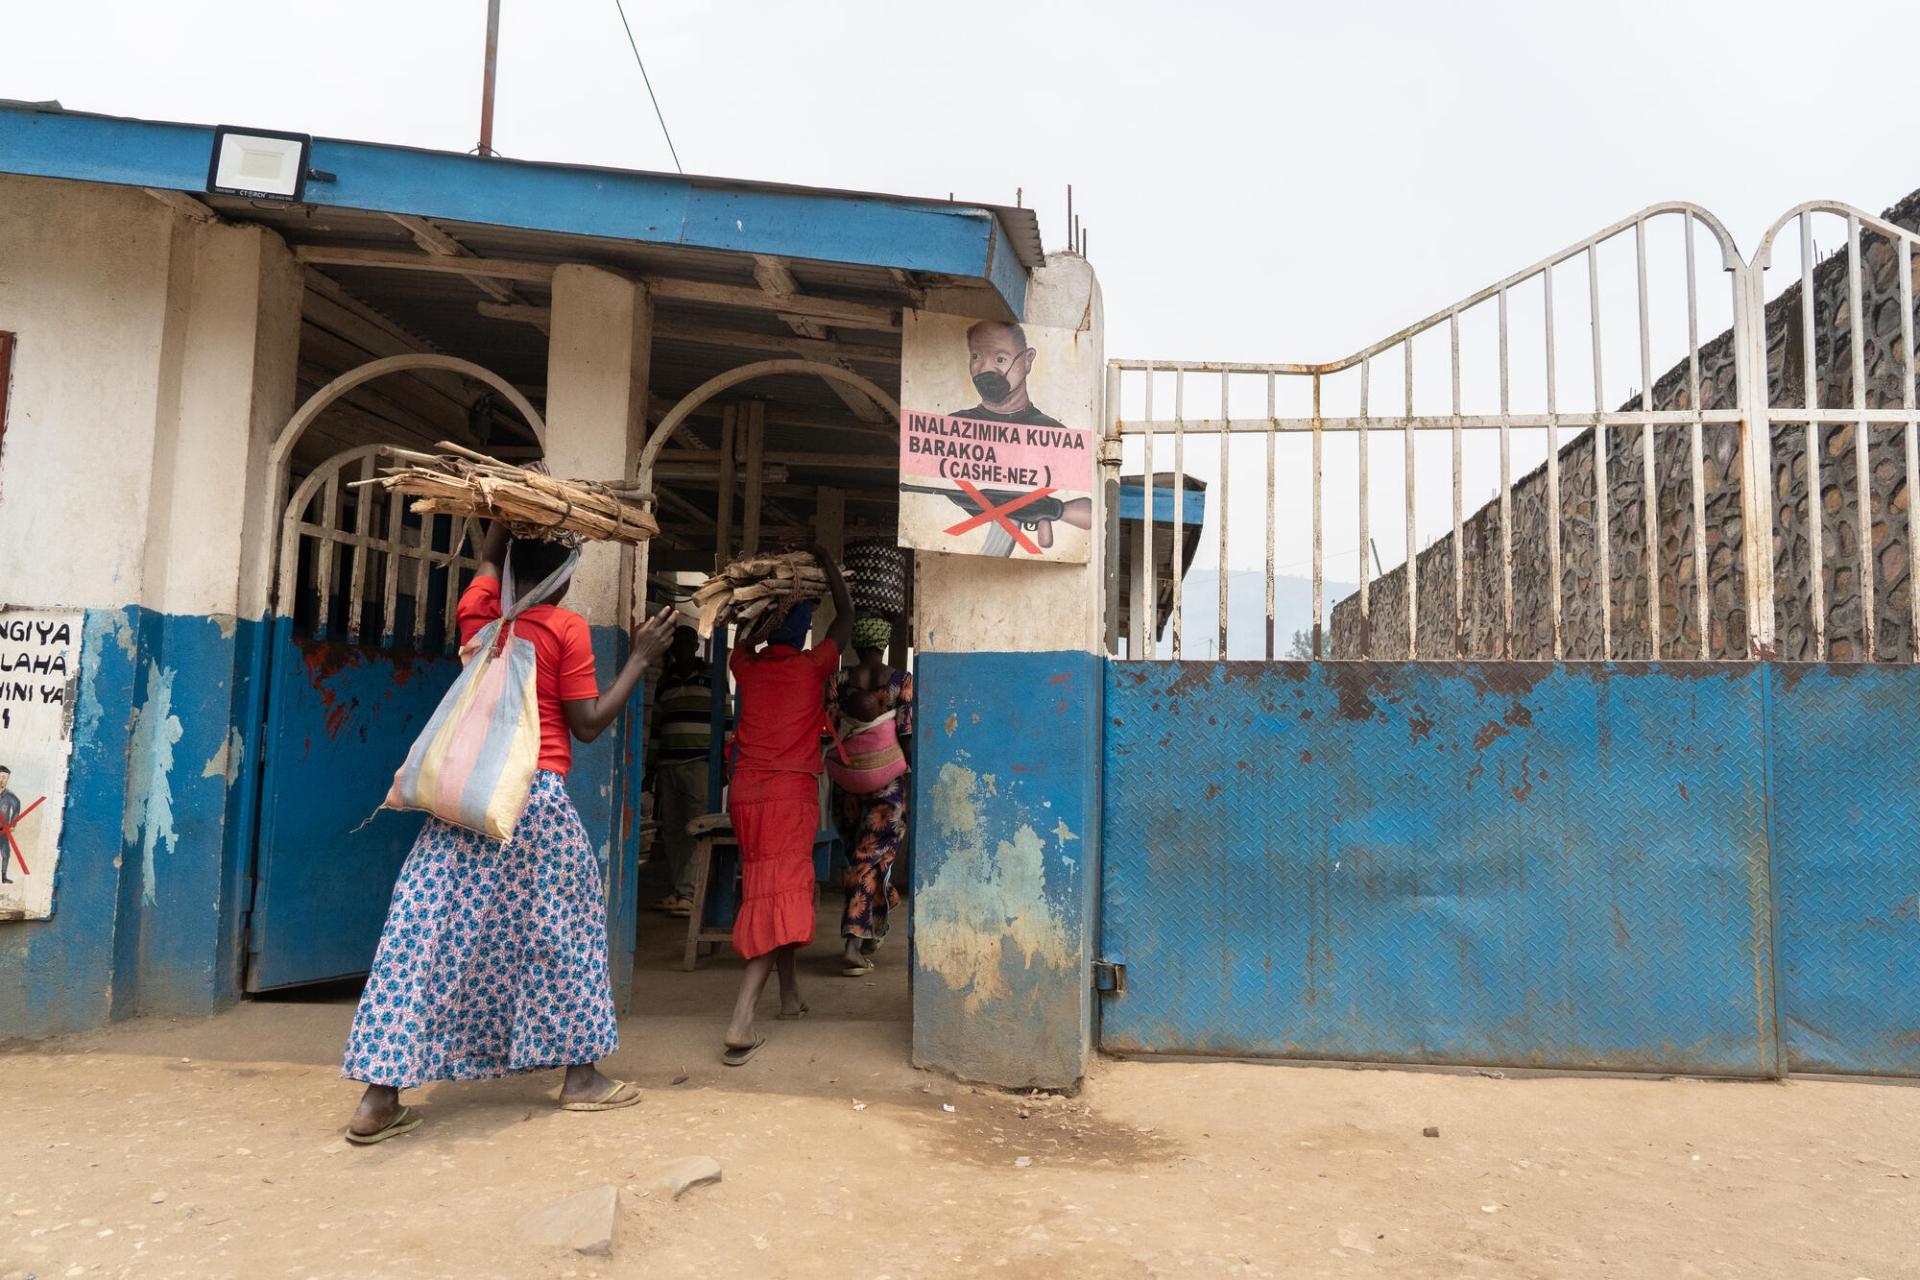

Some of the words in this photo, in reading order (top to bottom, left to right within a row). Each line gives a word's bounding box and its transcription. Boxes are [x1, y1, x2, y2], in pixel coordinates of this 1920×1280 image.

[909, 414, 1021, 445] INALAZIMIKA
[1027, 429, 1085, 450] KUVAA
[909, 436, 997, 463] BARAKOA
[1, 653, 66, 676] LAHA
